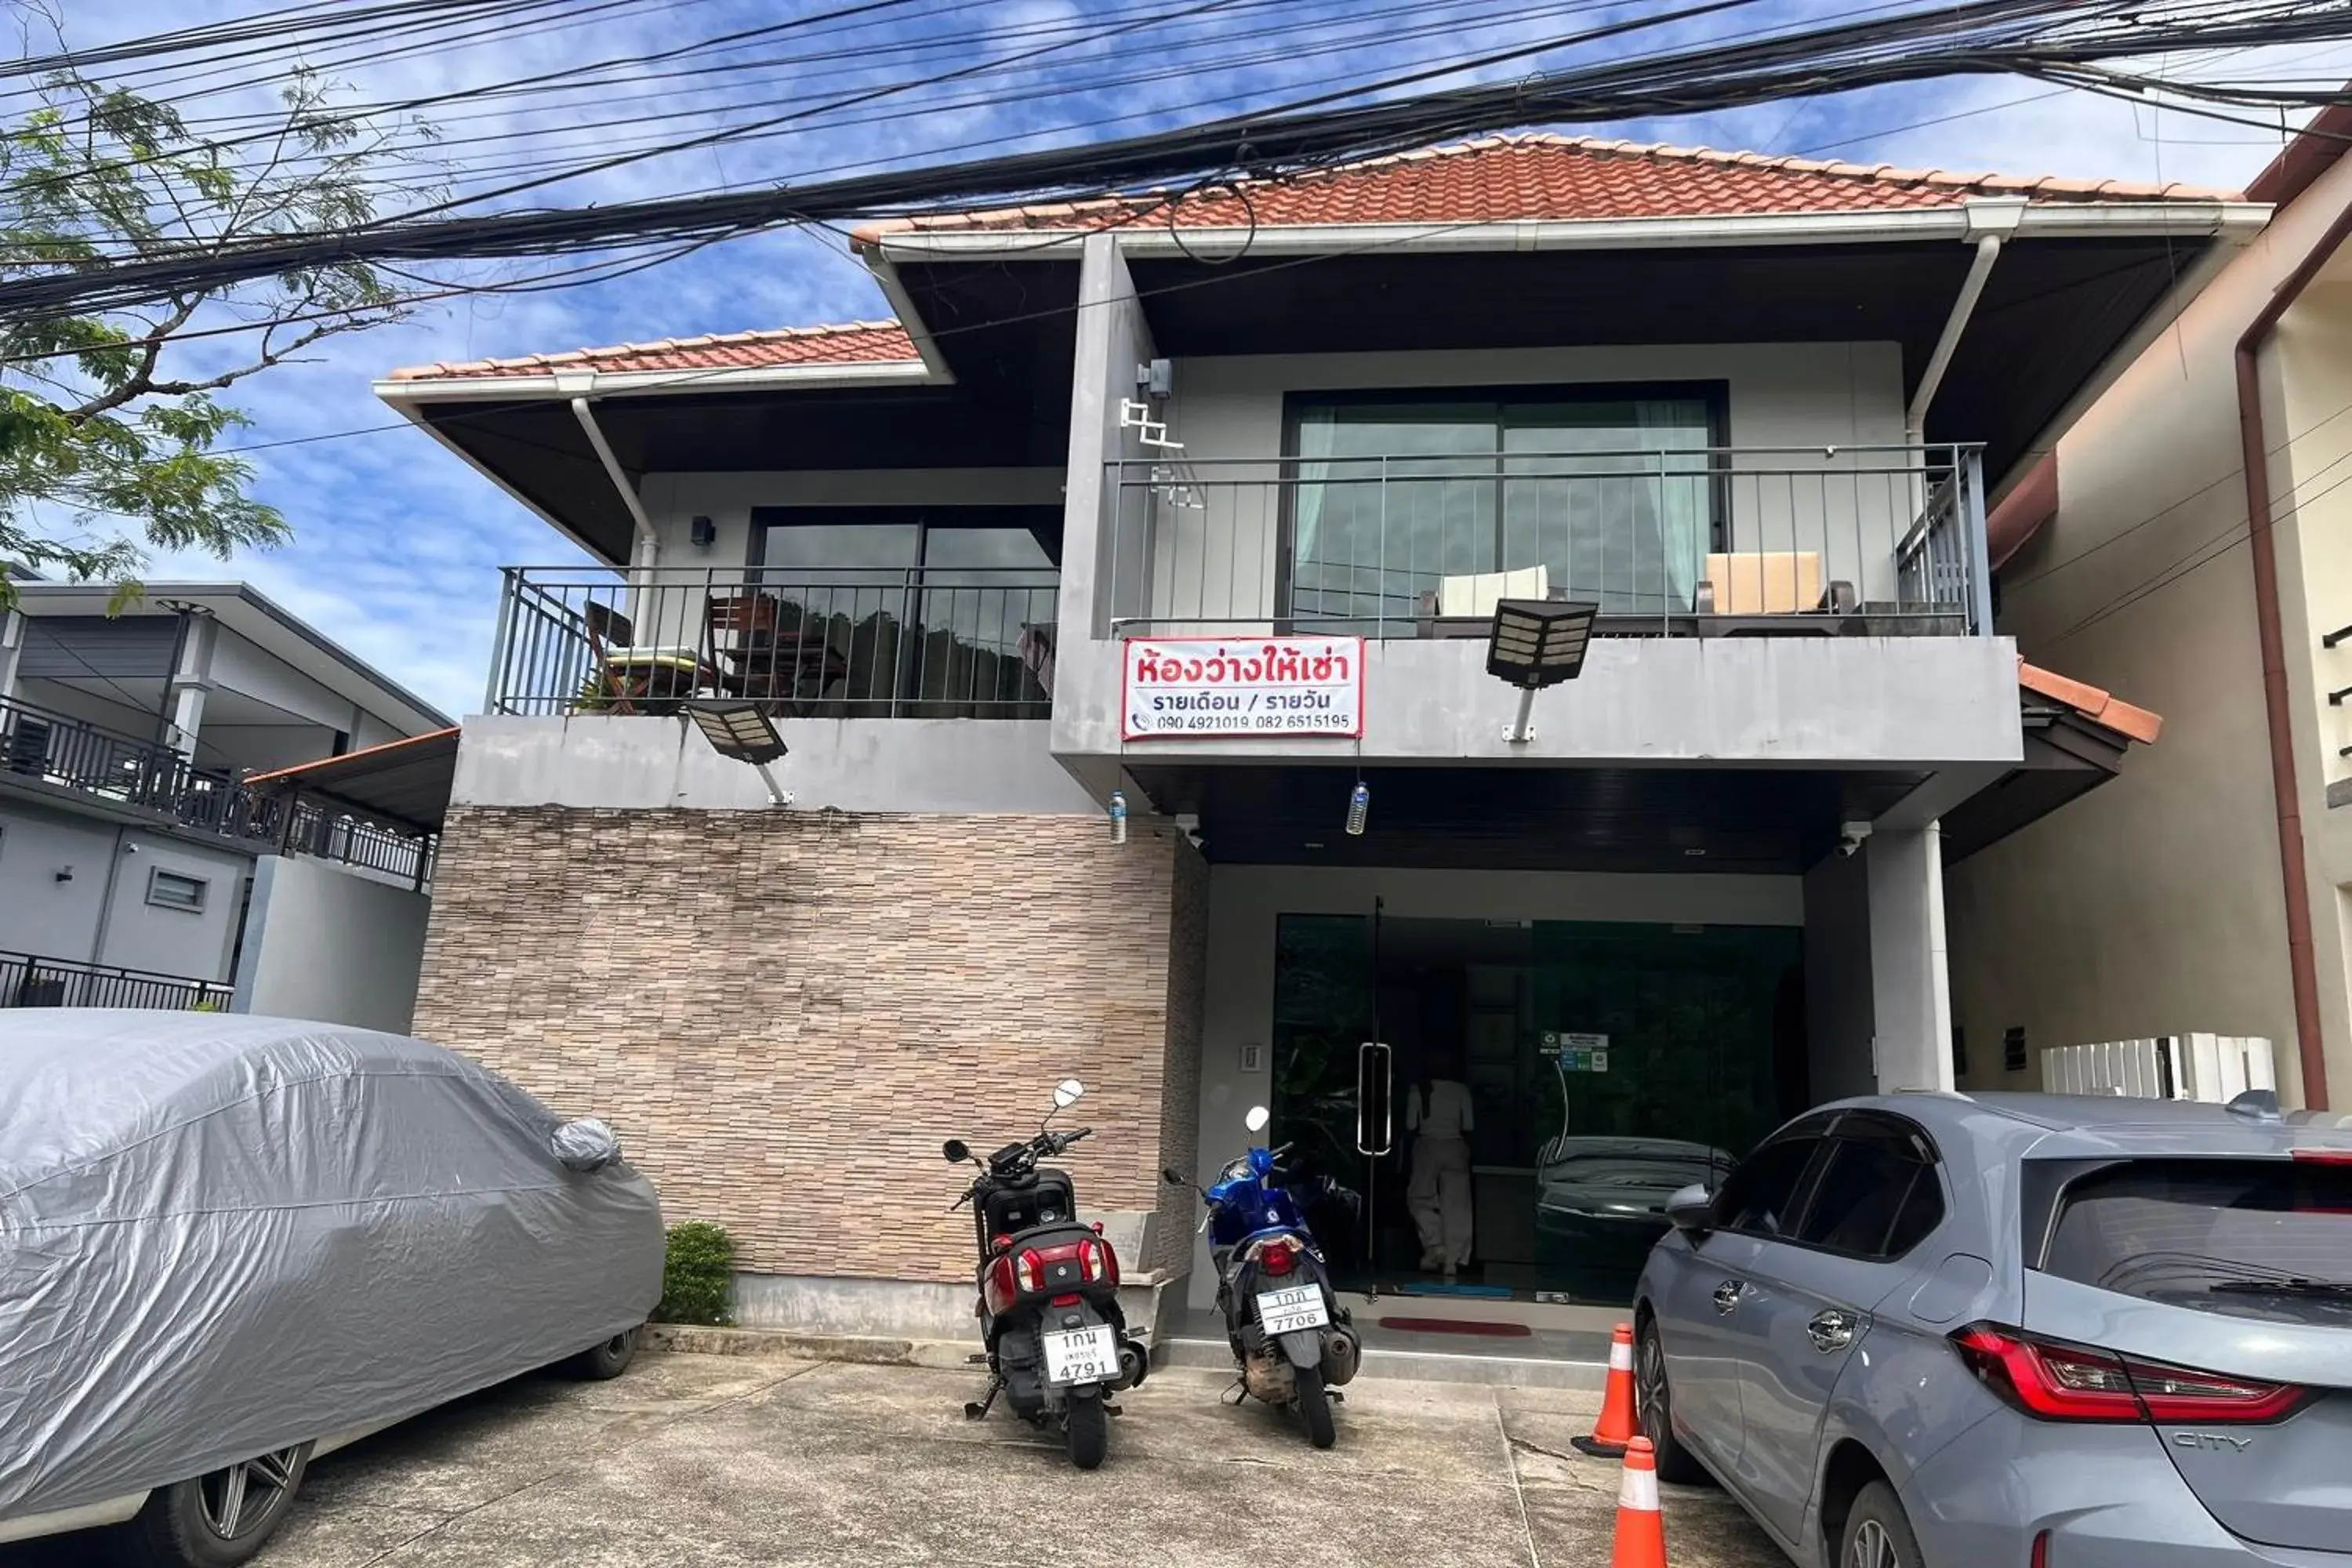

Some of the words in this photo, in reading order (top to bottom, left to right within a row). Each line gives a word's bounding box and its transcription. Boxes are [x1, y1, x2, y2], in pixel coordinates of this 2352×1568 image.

[1138, 645, 1348, 682] ห้องว่างให้เช่า
[1153, 691, 1240, 710] รายเดือน
[1247, 694, 1258, 712] /
[1266, 689, 1330, 710] รายวัน
[1157, 716, 1183, 729] 090
[1188, 716, 1249, 729] 4921019
[1256, 716, 1282, 728] 082
[1273, 1314, 1316, 1330] 7706
[1059, 1361, 1106, 1379] 4791
[2172, 1432, 2252, 1452] CITY
